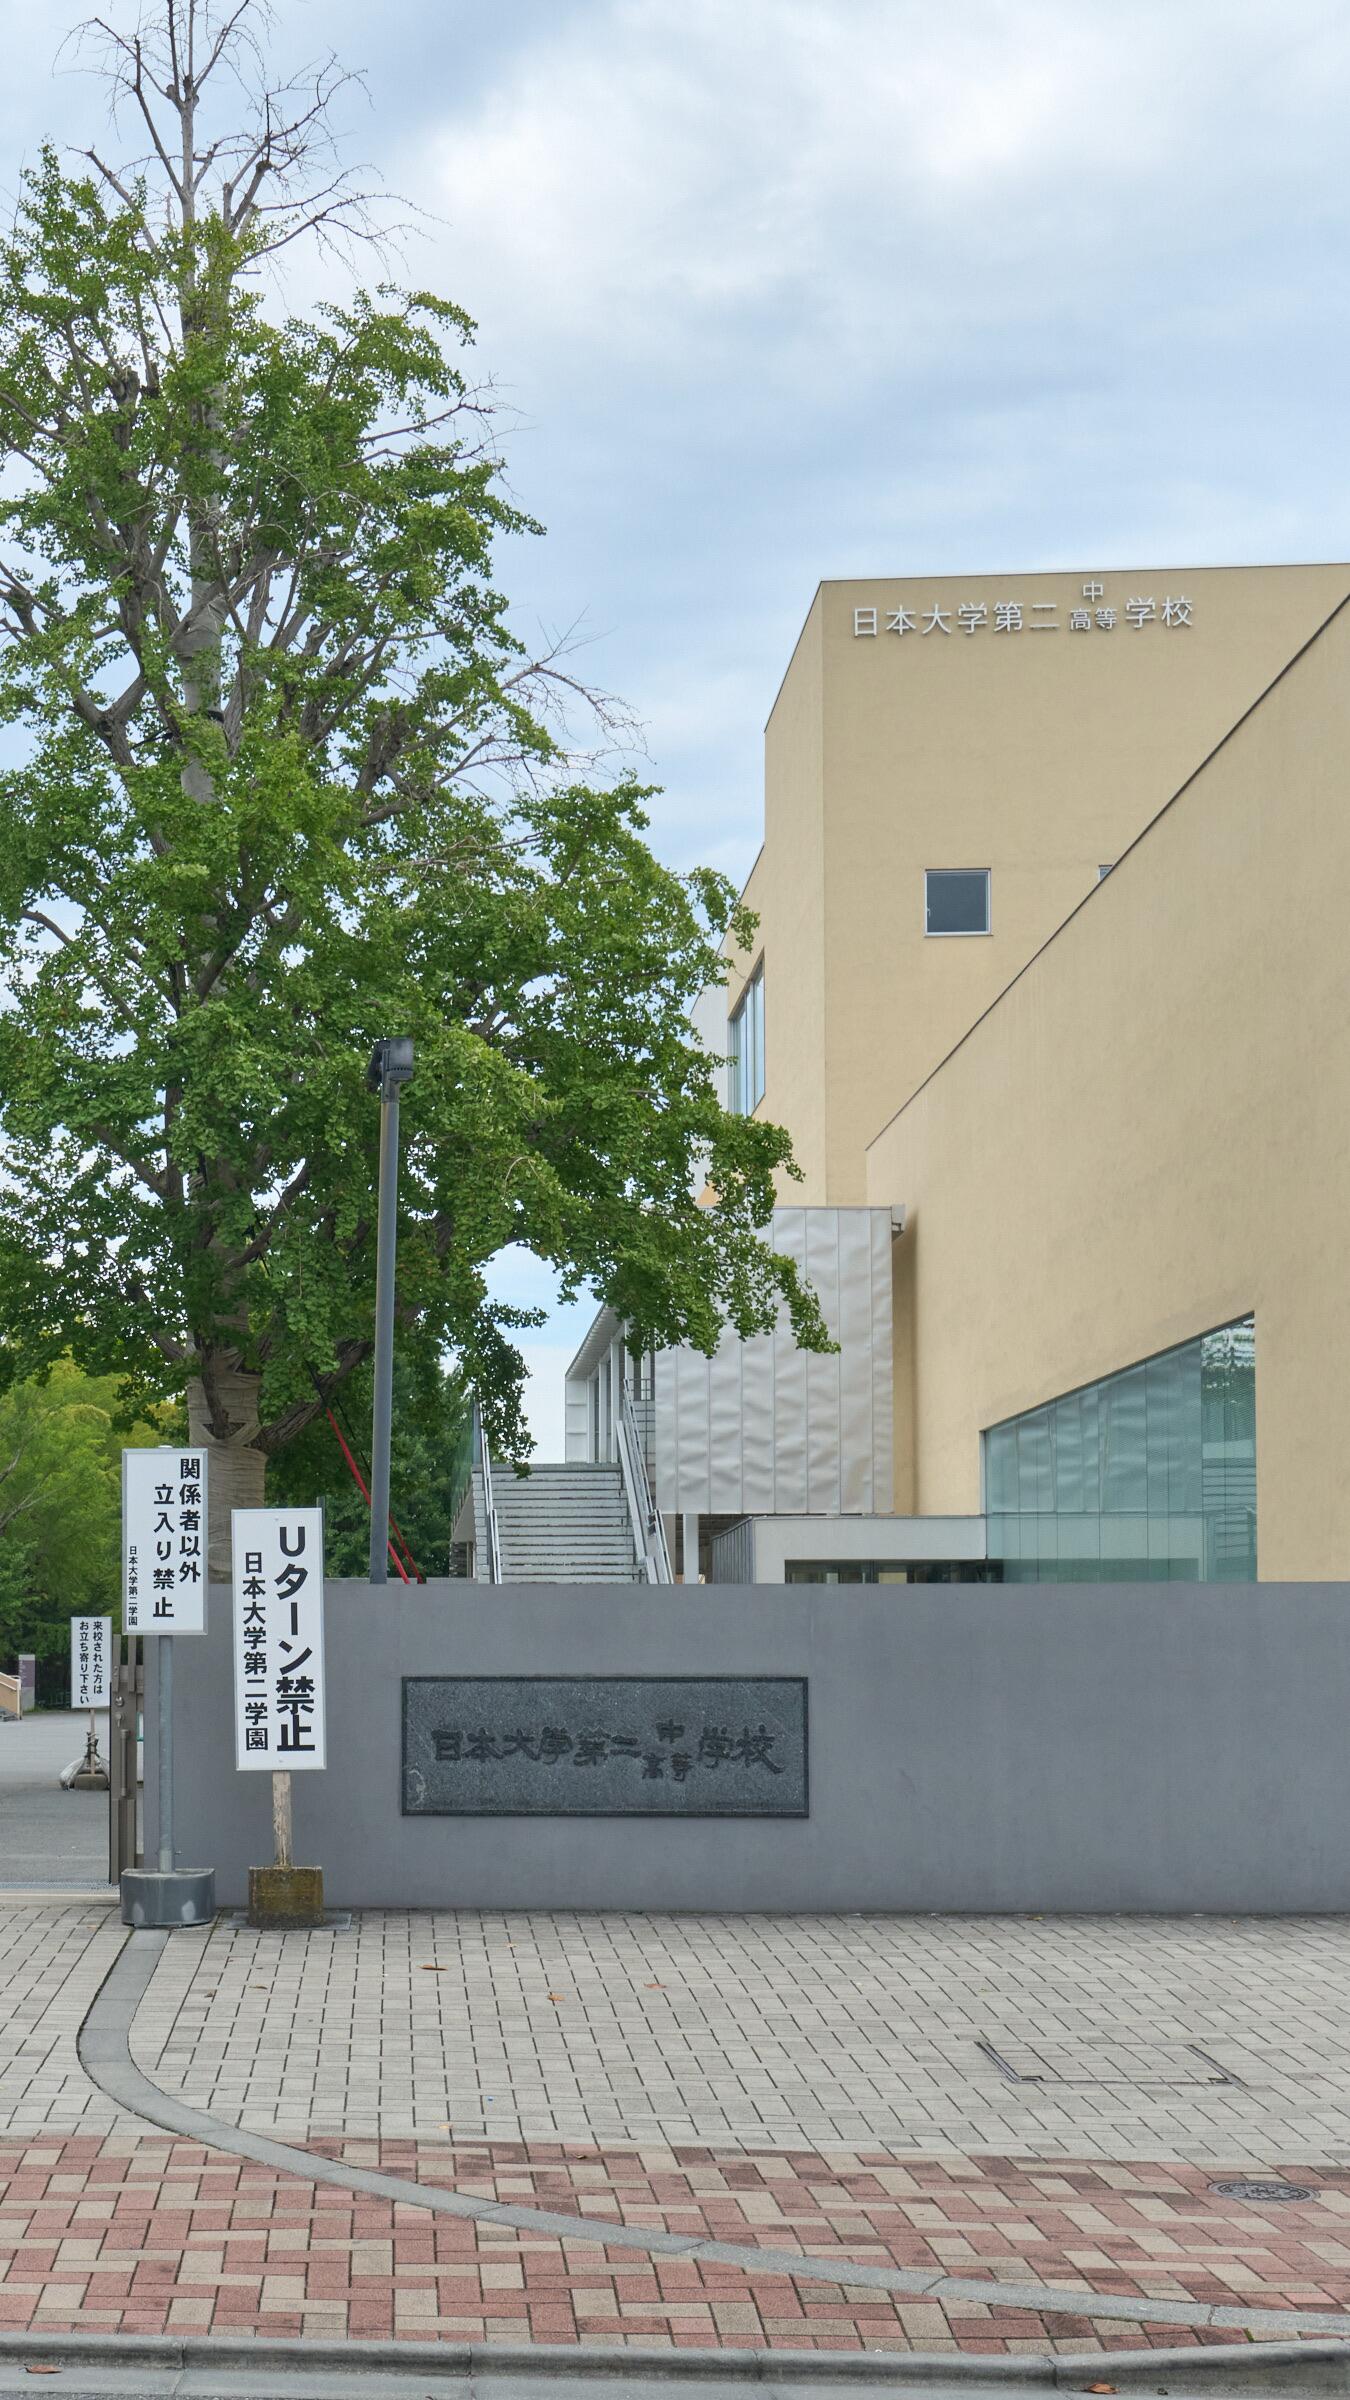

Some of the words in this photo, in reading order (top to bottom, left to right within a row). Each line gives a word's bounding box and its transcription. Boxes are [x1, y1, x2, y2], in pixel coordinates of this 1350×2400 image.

[153, 1483, 175, 1618] 立入り禁止
[179, 1458, 201, 1583] 関係者以外
[128, 1545, 138, 1626] 日本大学第二学園
[274, 1526, 316, 1752] Uターン禁止
[79, 1621, 90, 1704] お立ち寄り下さい
[93, 1621, 104, 1694] 来校された方は
[242, 1552, 269, 1751] 日本大学第二学園
